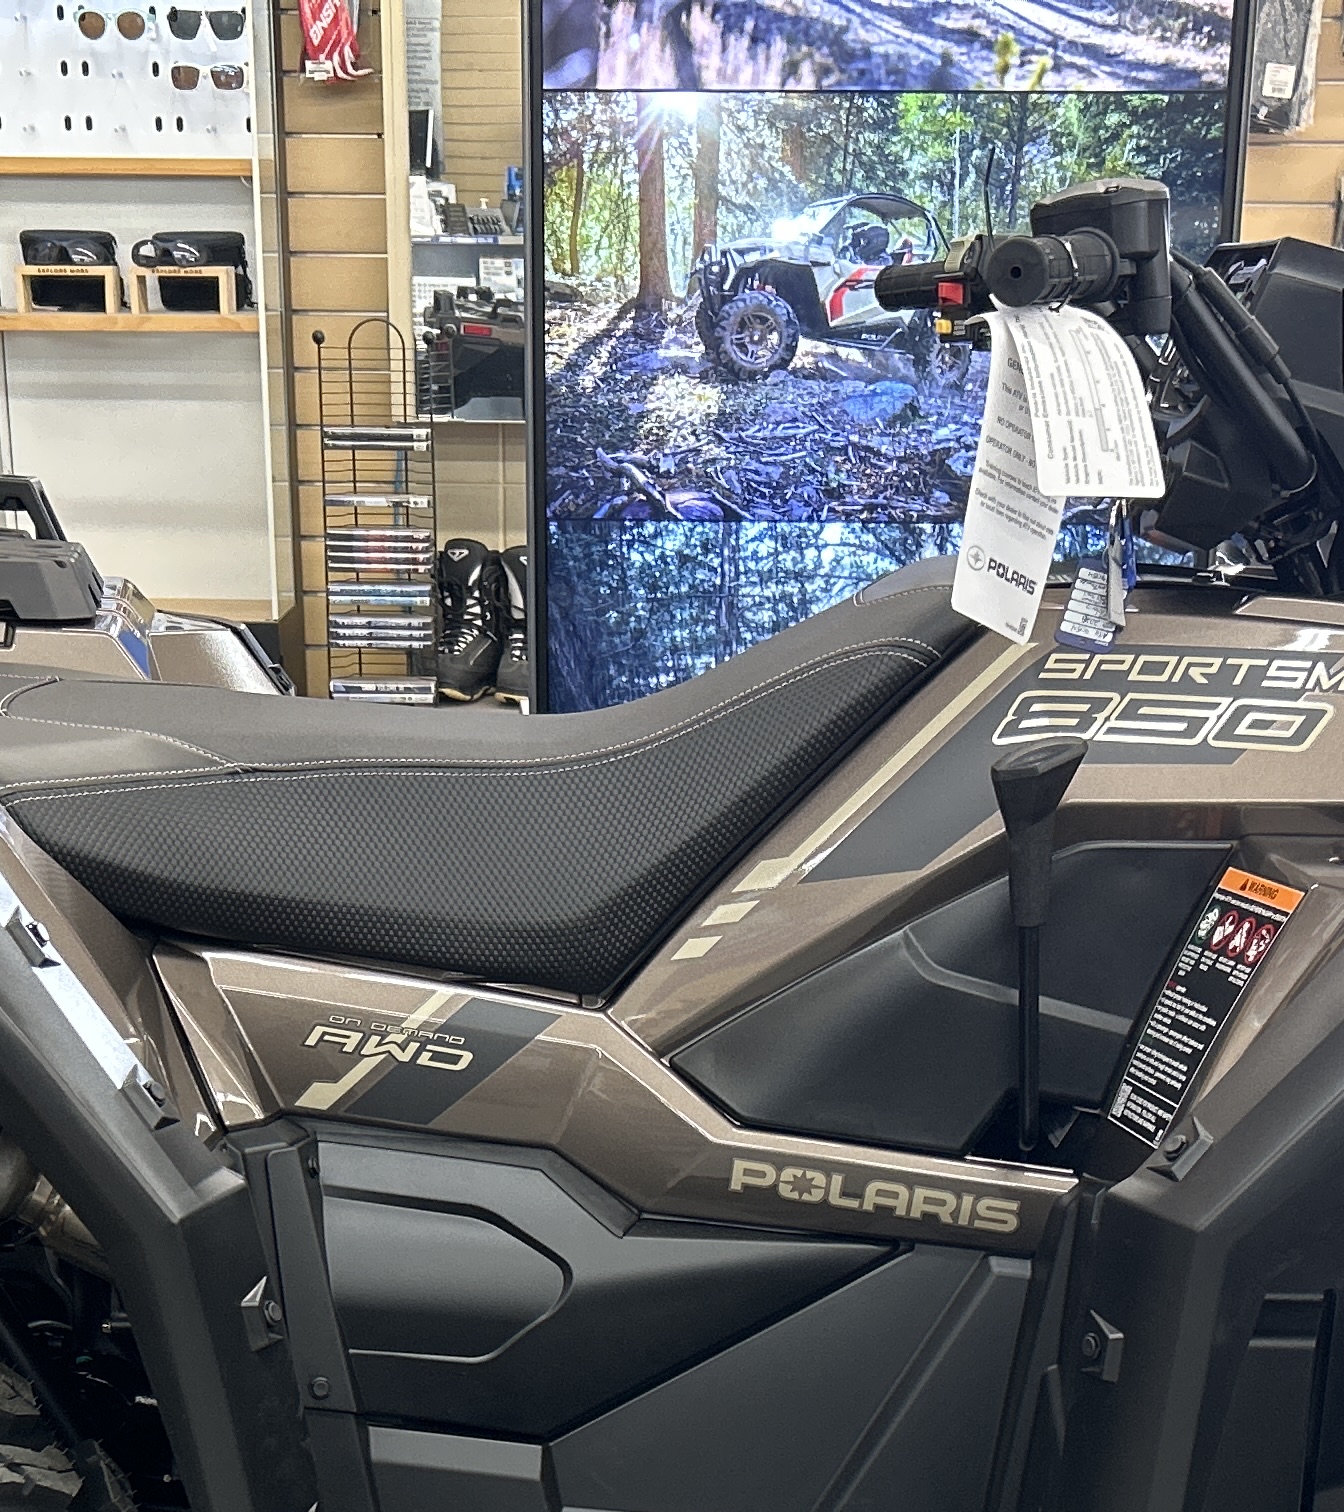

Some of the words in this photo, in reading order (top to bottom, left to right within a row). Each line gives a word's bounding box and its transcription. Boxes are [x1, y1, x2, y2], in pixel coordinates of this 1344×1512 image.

[986, 557, 1038, 595] POLARIS
[991, 689, 1337, 753] 850
[303, 1022, 476, 1073] AWD
[329, 1014, 363, 1026] ON
[370, 1020, 467, 1046] DEMAND
[729, 1156, 1022, 1235] POLARIS
